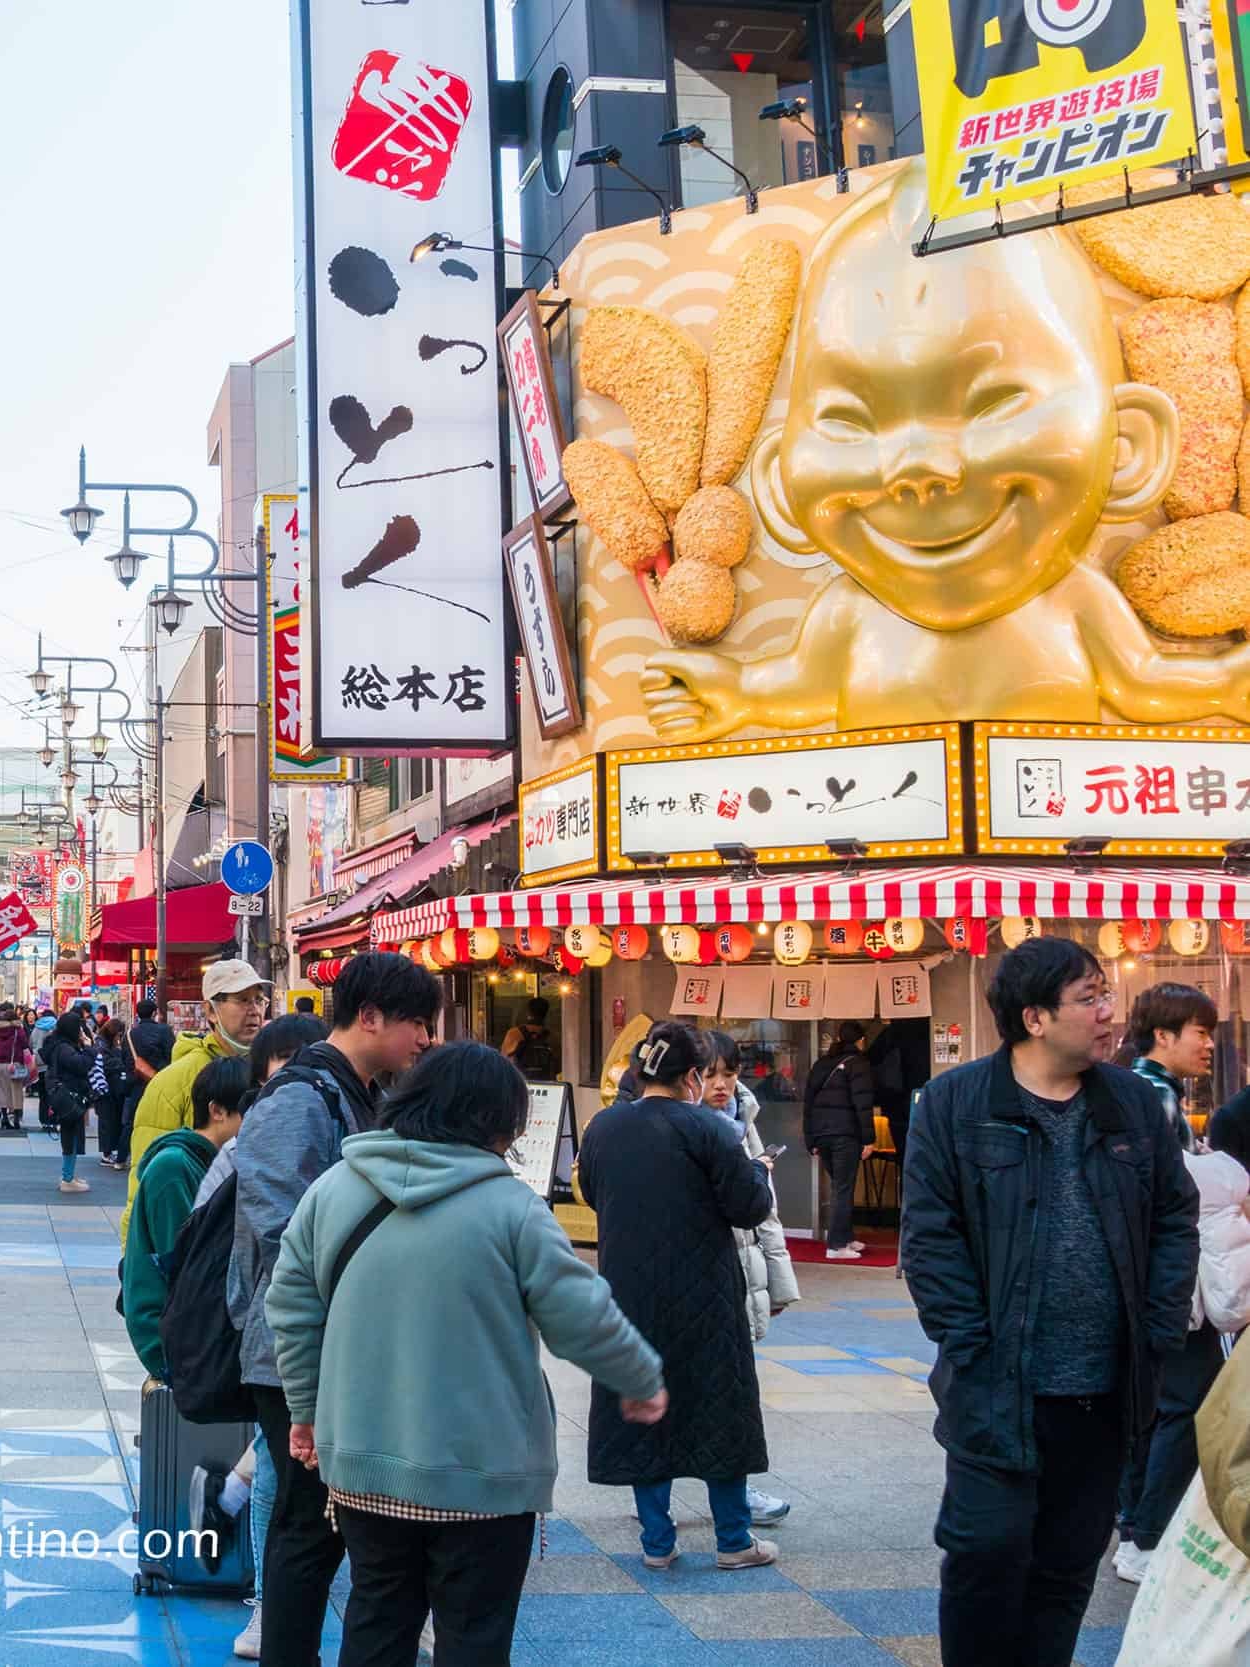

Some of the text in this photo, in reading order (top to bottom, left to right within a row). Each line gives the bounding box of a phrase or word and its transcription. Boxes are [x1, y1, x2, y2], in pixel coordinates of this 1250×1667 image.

[959, 67, 1161, 149] 新世界遊技場
[959, 111, 1170, 197] チャンピオン
[340, 662, 486, 713] 総本店
[624, 793, 714, 820] 新世界
[231, 900, 261, 912] 9-22
[671, 930, 682, 957] ビール
[866, 931, 885, 951] 牛
